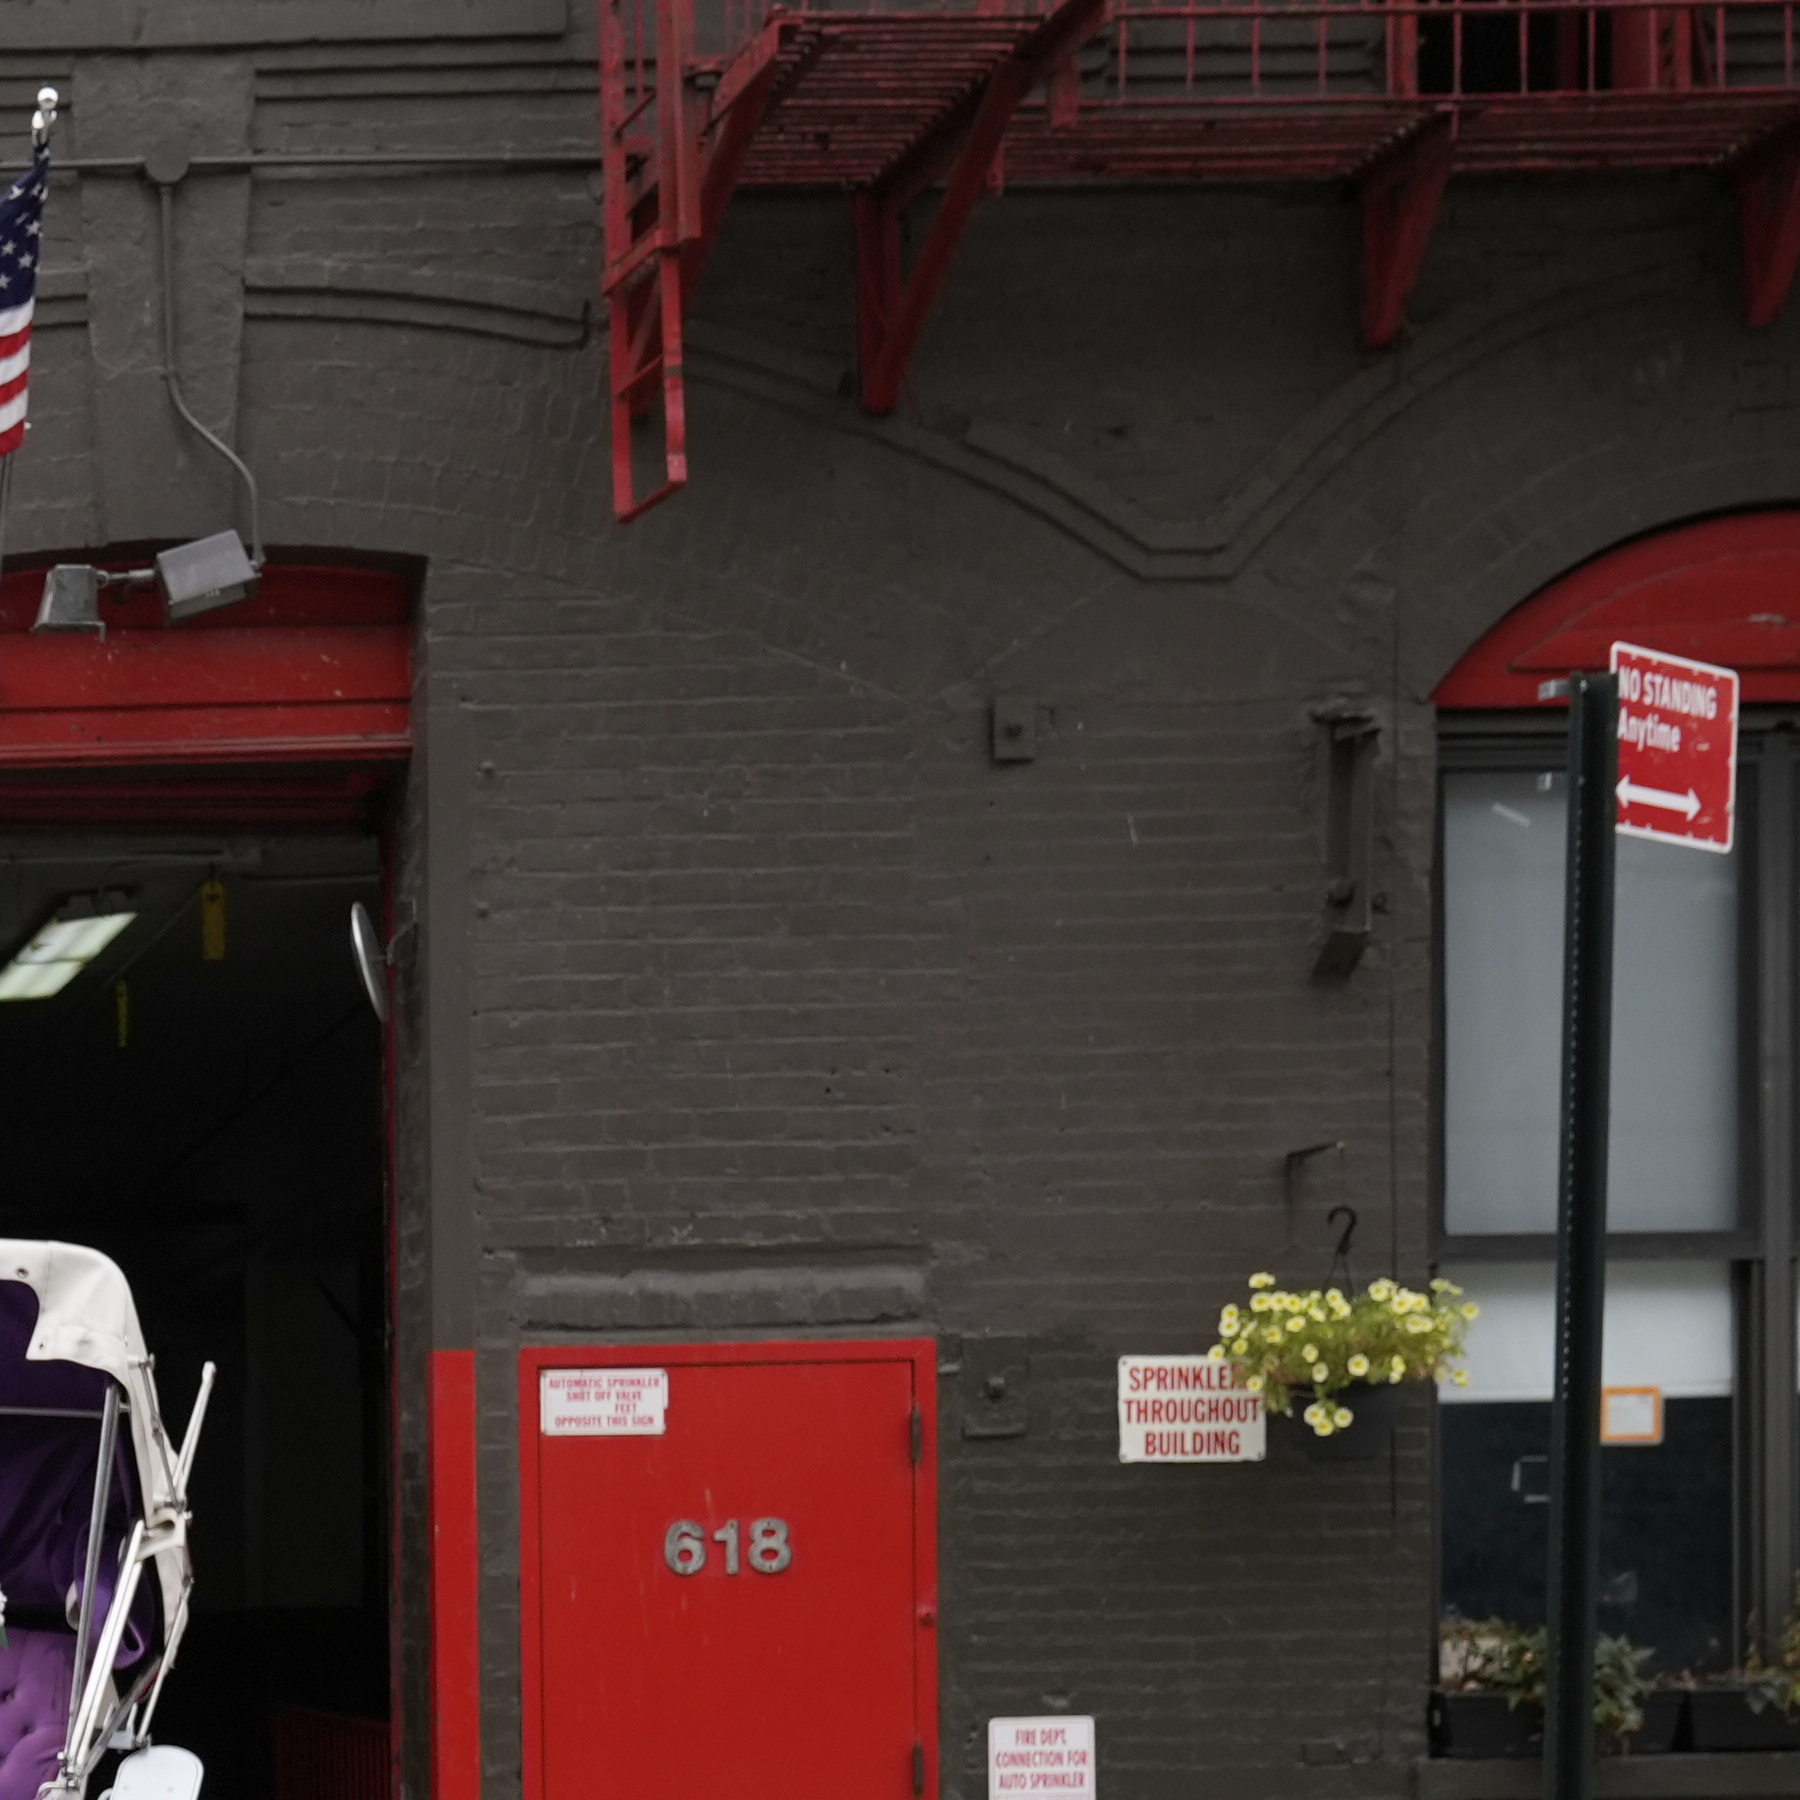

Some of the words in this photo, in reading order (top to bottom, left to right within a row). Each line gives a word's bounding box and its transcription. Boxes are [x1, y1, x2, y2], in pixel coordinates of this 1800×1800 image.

[1618, 666, 1641, 702] NO
[1643, 671, 1718, 720] STANDING
[1618, 706, 1682, 752] Anytime
[549, 1378, 602, 1389] AUTOMATIC
[608, 1377, 660, 1388] SPRINKLER
[1129, 1366, 1248, 1391] SPRINKLE
[595, 1391, 611, 1401] OFF
[616, 1391, 642, 1401] VALVE
[615, 1403, 637, 1413] FEET
[1124, 1398, 1260, 1424] THROUGHOUT
[555, 1416, 602, 1427] OPPOSITE
[608, 1416, 628, 1426] THIS
[632, 1416, 654, 1426] SIGN
[1144, 1430, 1242, 1456] BUILDING
[663, 1516, 793, 1576] 618
[1015, 1729, 1036, 1746] FIRE
[996, 1750, 1064, 1768] CONNECTION
[1067, 1749, 1089, 1767] FOR
[998, 1772, 1027, 1789] AUTO
[1030, 1770, 1085, 1789] SPRINKLER
